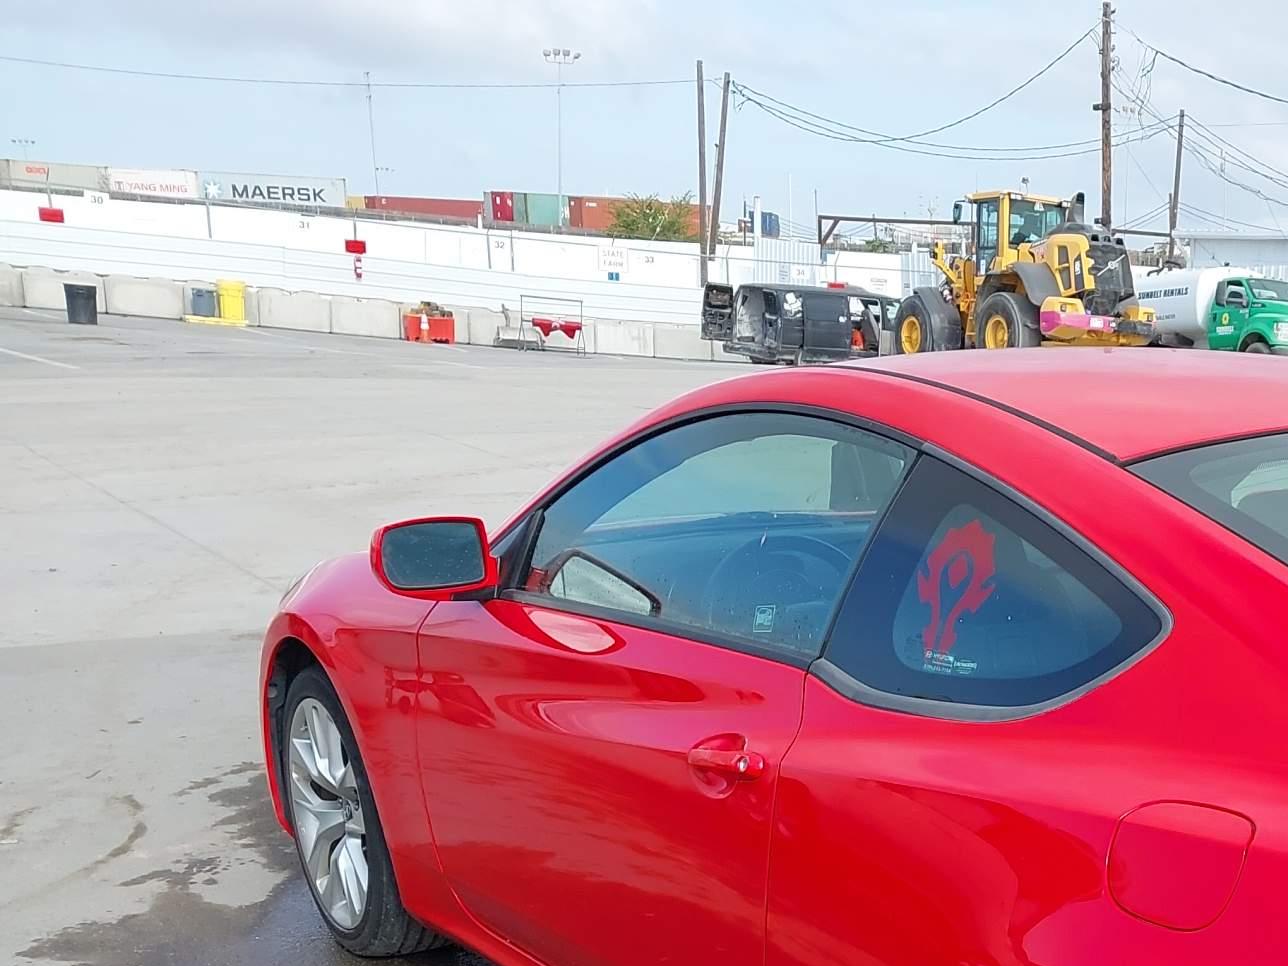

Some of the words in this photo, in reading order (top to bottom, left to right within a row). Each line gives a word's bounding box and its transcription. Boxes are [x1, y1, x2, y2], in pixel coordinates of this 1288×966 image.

[127, 182, 156, 192] YANG
[160, 184, 188, 193] MING
[232, 184, 326, 202] MAERSK
[495, 240, 505, 249] 32
[1163, 287, 1189, 297] RENTALS
